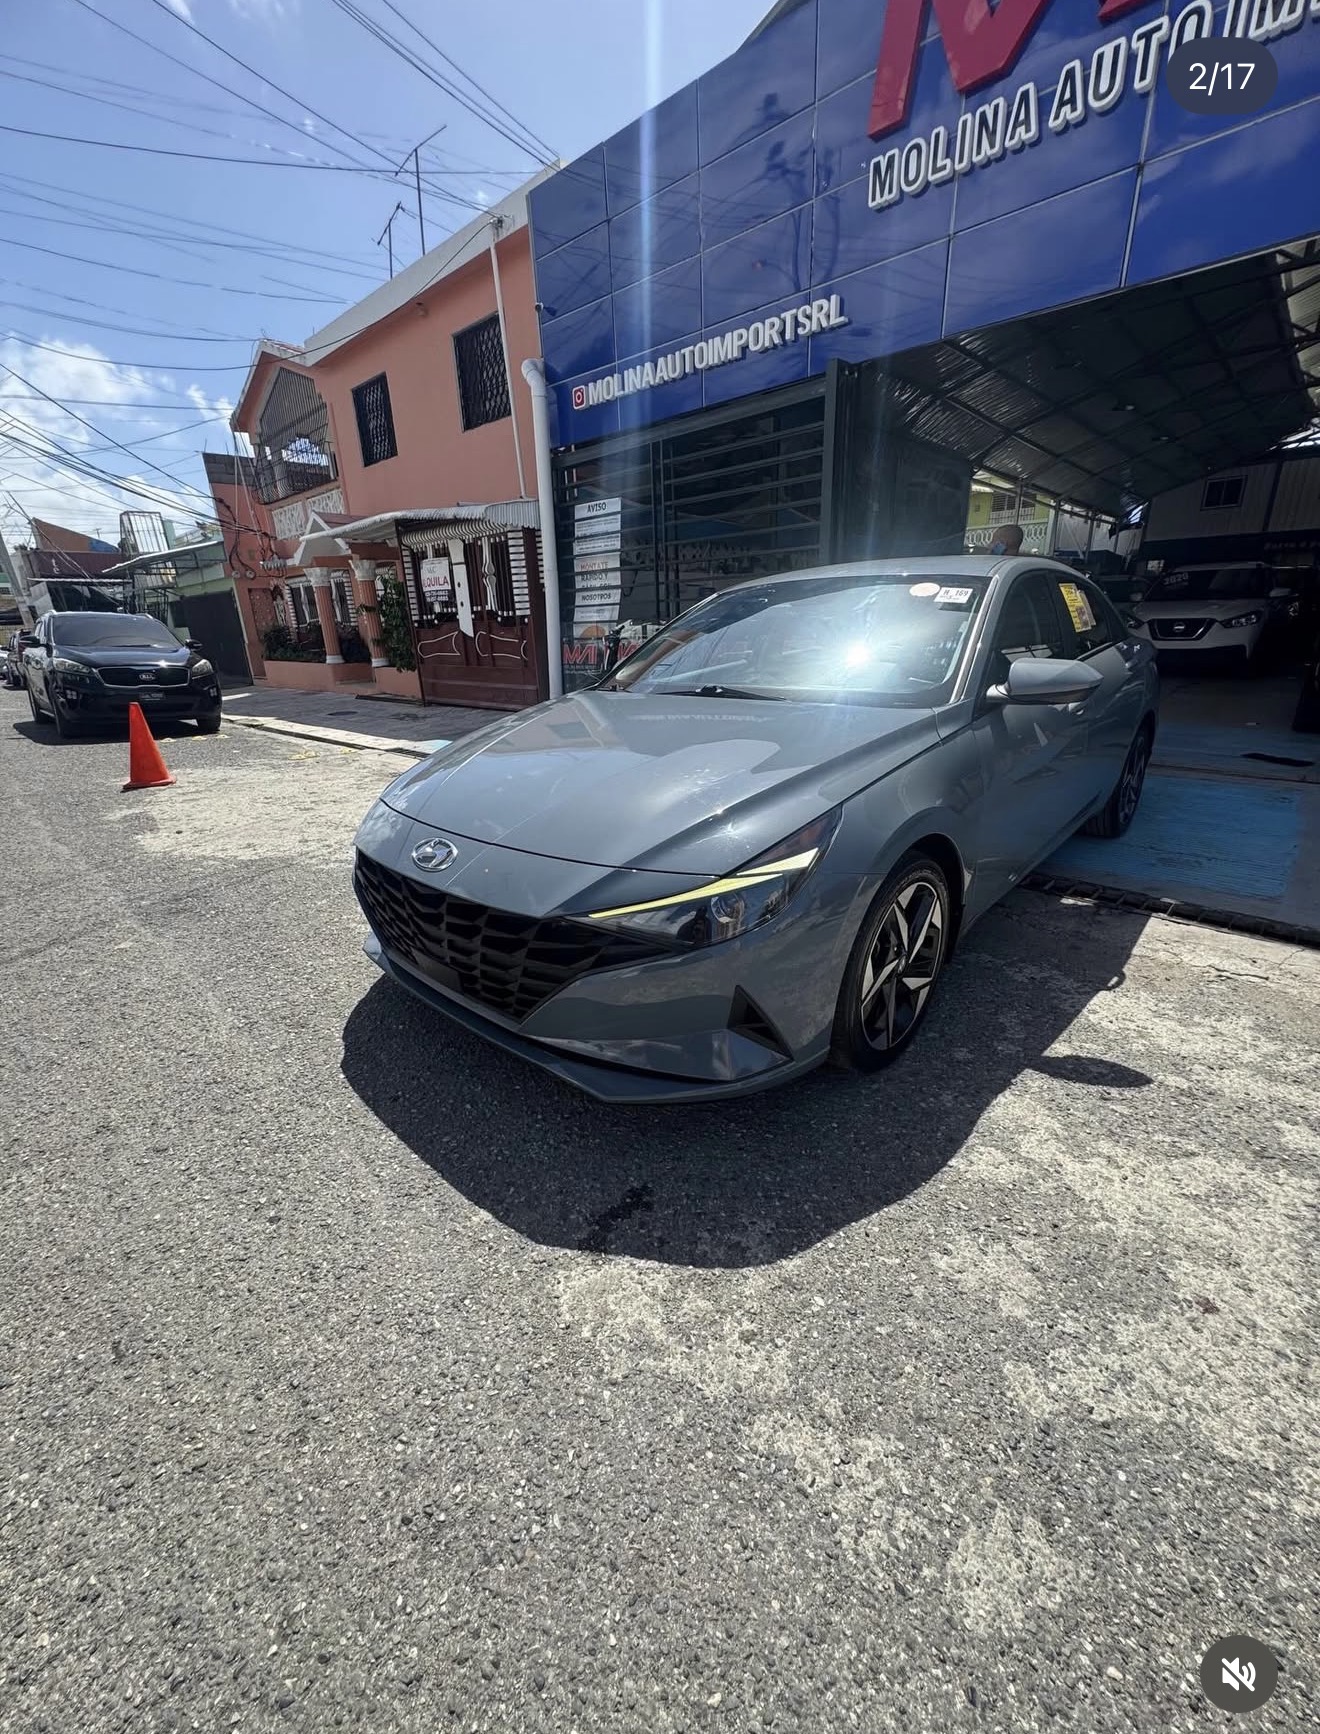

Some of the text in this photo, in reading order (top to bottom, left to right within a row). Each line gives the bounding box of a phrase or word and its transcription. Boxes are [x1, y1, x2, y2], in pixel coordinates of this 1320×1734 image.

[868, 82, 1038, 211] MOLINA
[588, 294, 849, 405] MOLINAAUTOIMPORTSRL
[587, 502, 607, 514] AVISO
[582, 592, 611, 602] NOSOTROS
